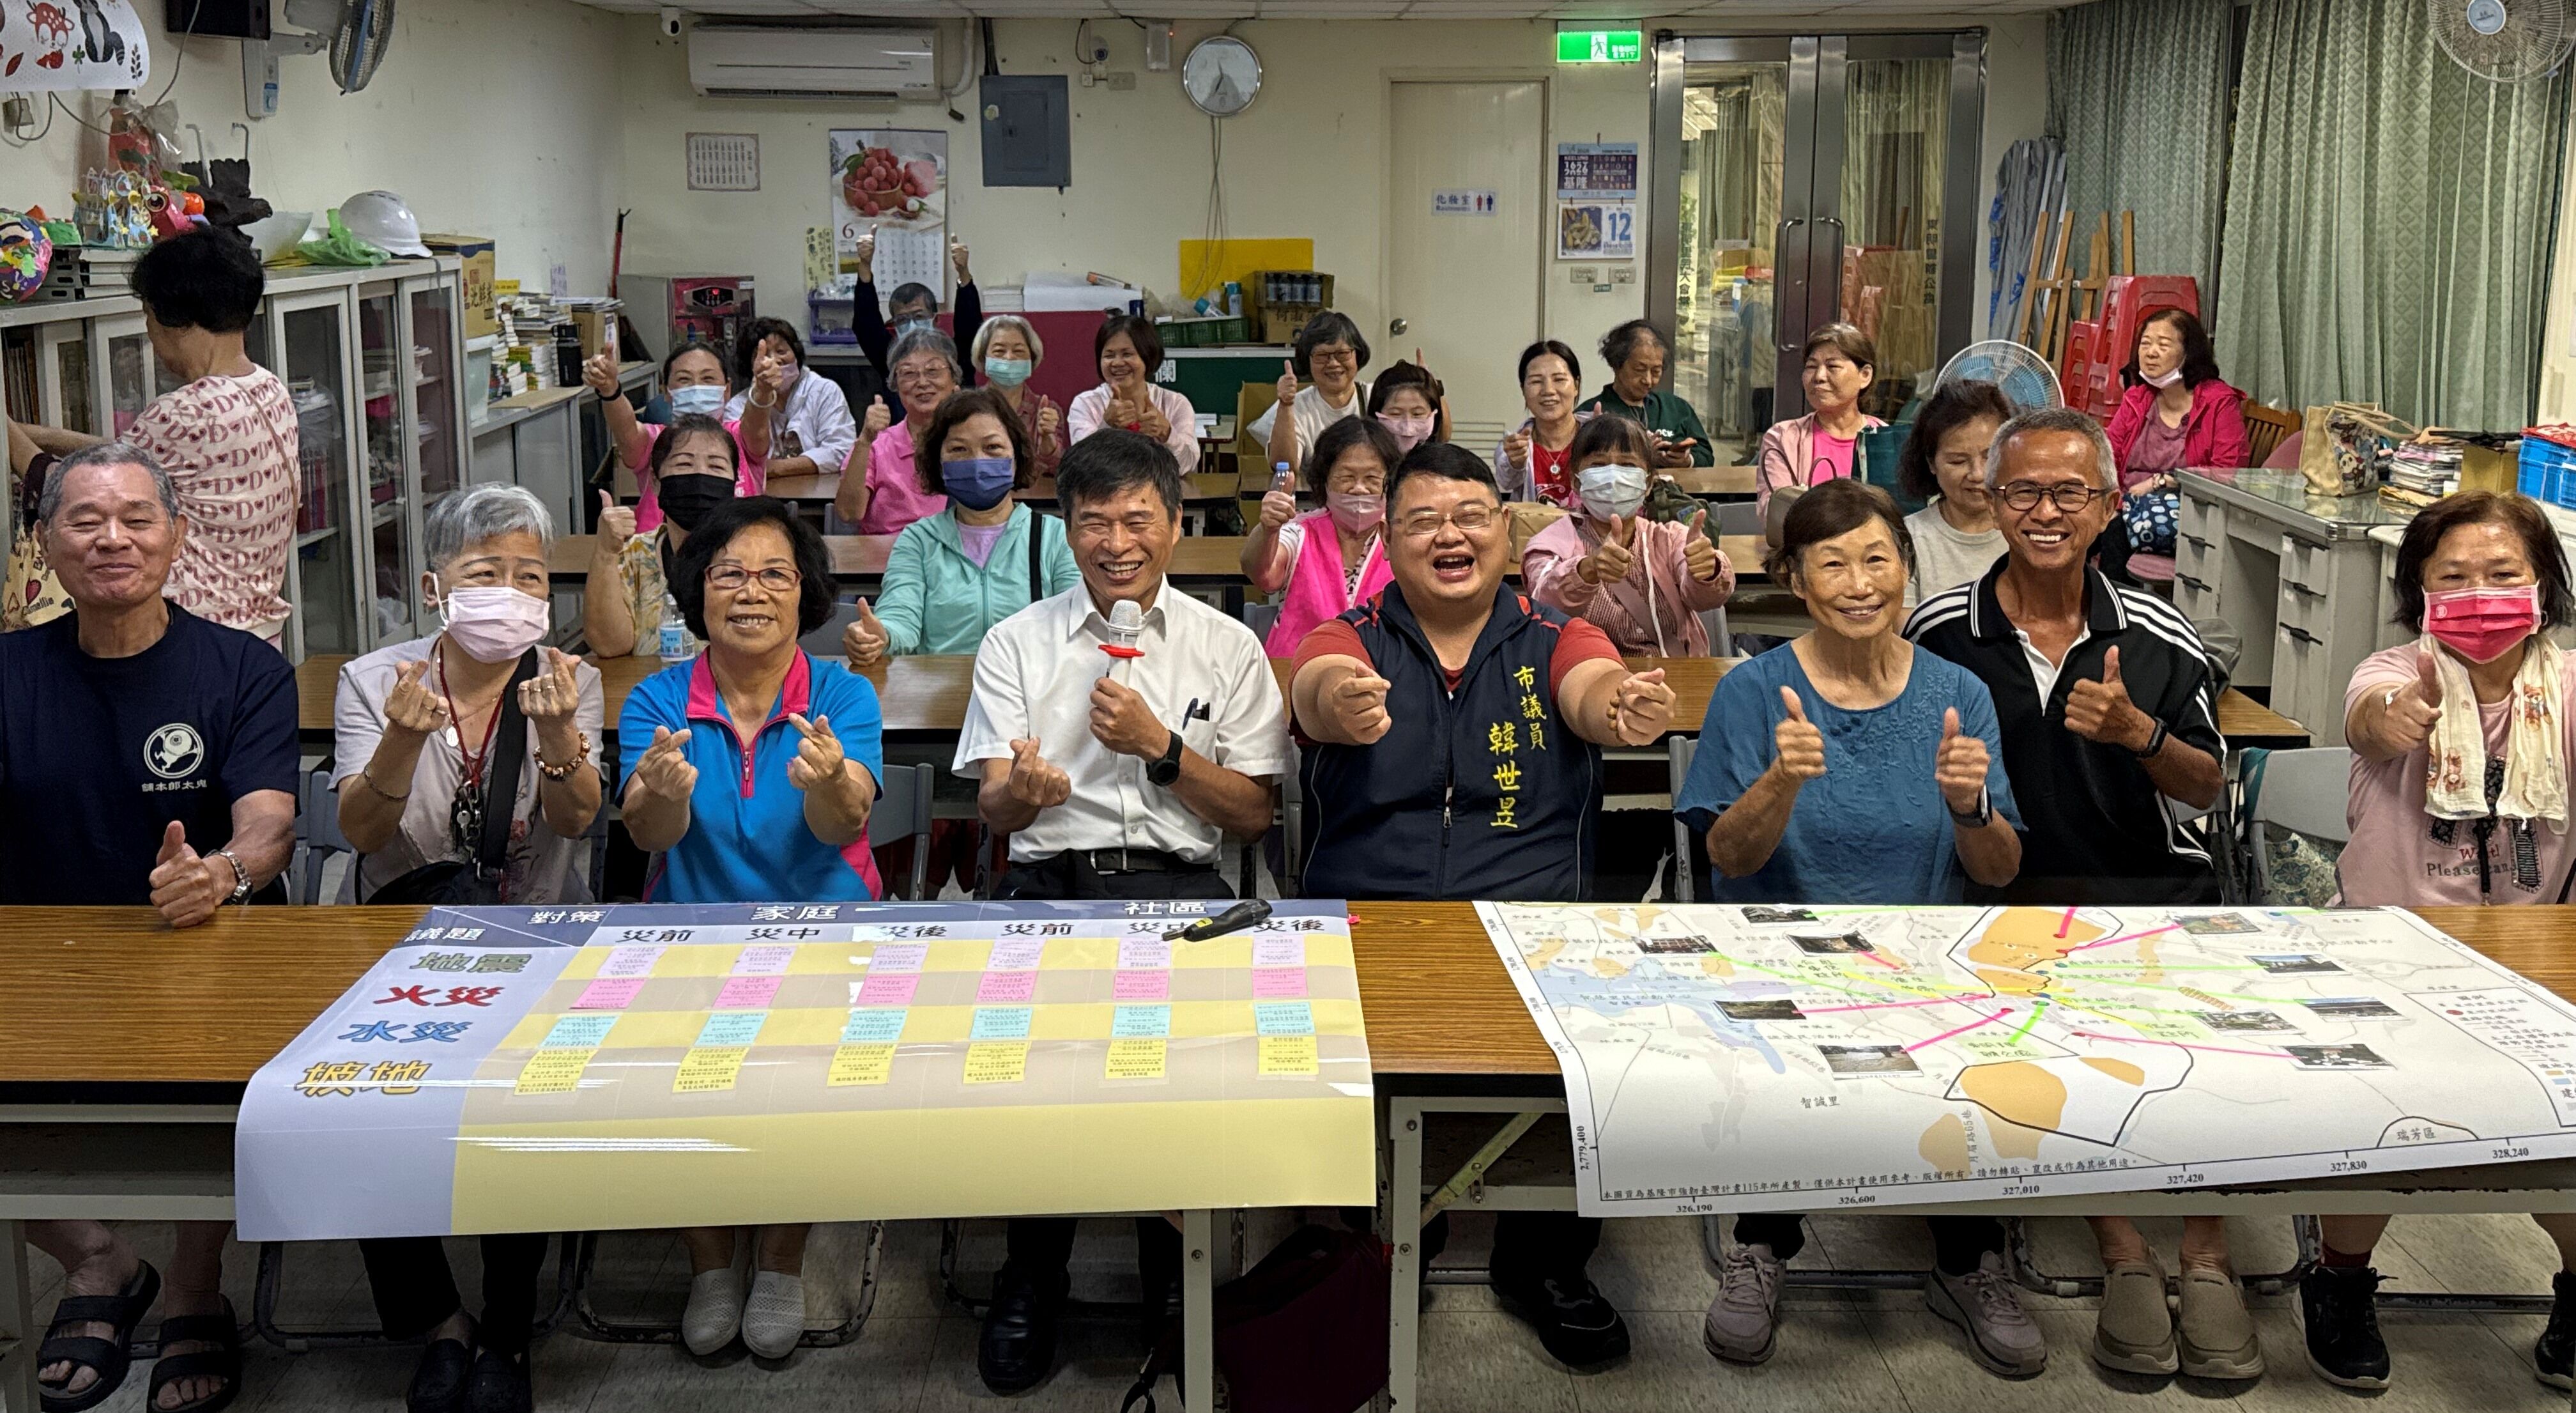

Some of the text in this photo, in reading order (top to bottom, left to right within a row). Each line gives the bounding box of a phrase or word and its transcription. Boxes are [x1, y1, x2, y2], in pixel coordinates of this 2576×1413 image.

[842, 224, 854, 238] 6
[1609, 213, 1631, 241] 12
[1513, 665, 1547, 750] 市議員
[1489, 722, 1521, 828] 韓世昱
[528, 901, 1207, 925] 對策 家庭 社區
[403, 927, 486, 943] 議題
[616, 929, 695, 943] 災前
[746, 927, 820, 940] 災中
[1001, 923, 1074, 936] 災前
[1254, 919, 1326, 932] 災後
[409, 952, 532, 973] 地震
[373, 985, 505, 1007] 火災
[337, 1020, 473, 1043] 水災
[294, 1060, 433, 1097] 坡地
[2561, 1088, 2576, 1099] 建
[1800, 1095, 1841, 1109] 智誠里
[2396, 1127, 2436, 1141] 瑞芳區
[1576, 1125, 1590, 1171] 2,779,400
[2492, 1147, 2529, 1159] 328,240
[2330, 1160, 2367, 1172] 327,830
[2166, 1173, 2204, 1185] 327,420
[2002, 1185, 2040, 1196] 327,010
[1675, 1203, 1713, 1213] 326,190
[1838, 1195, 1876, 1205] 326,600
